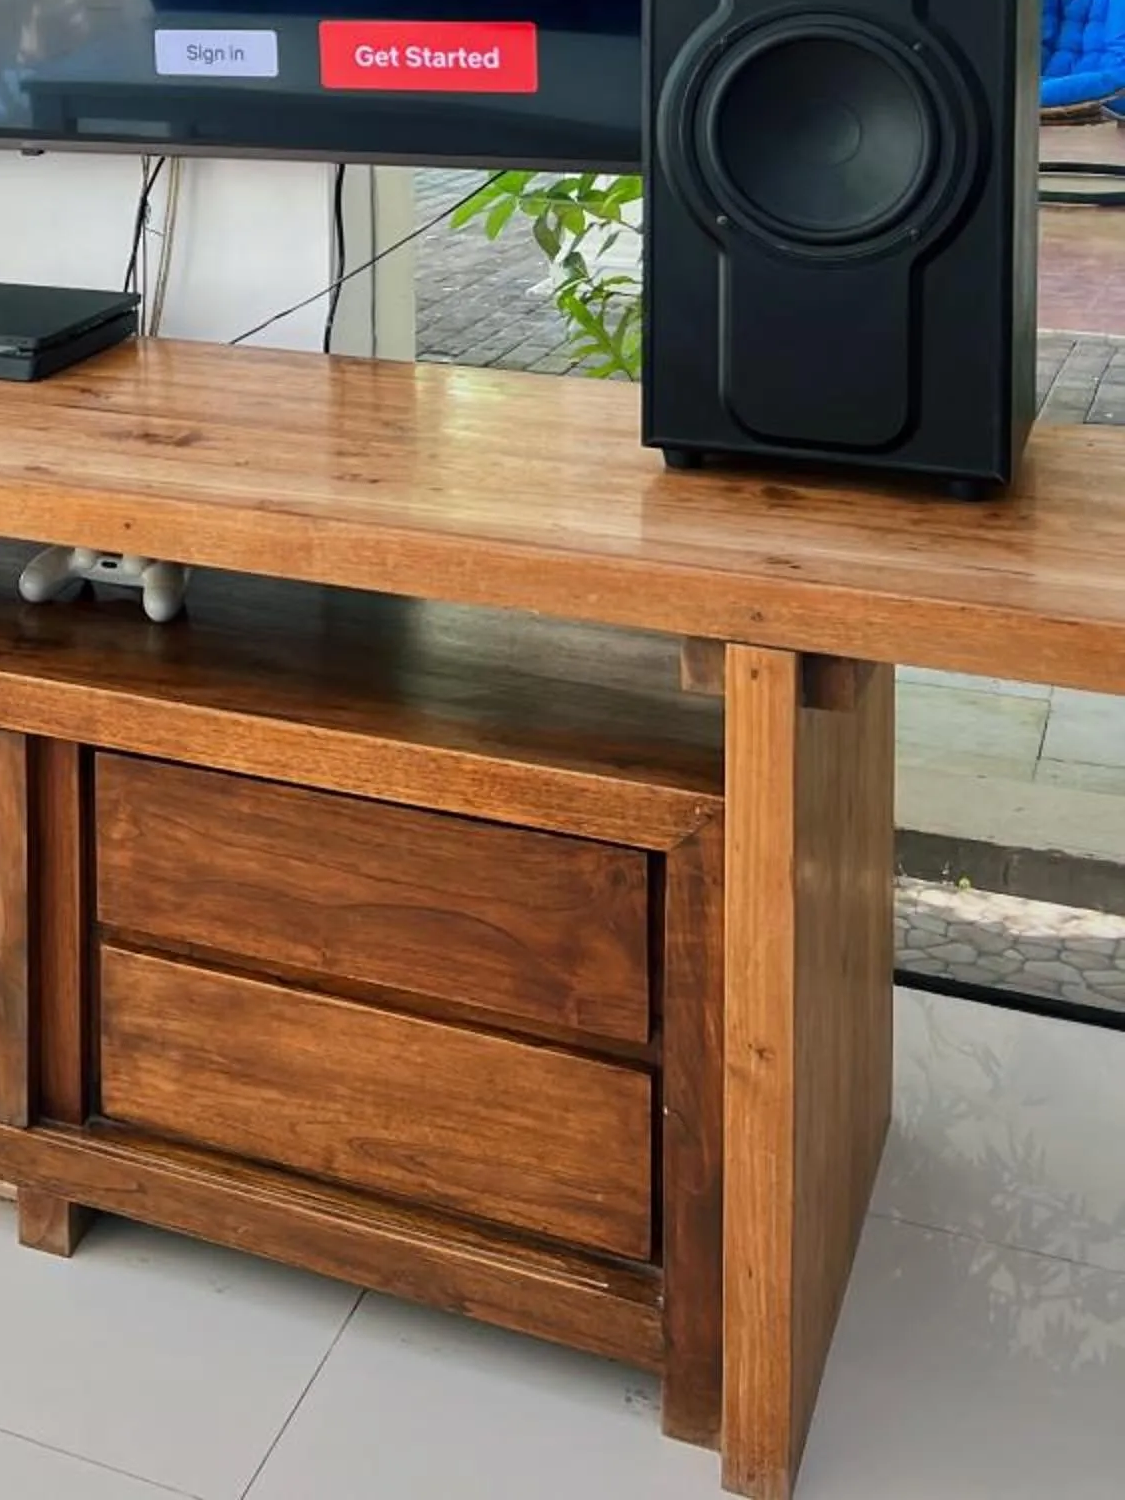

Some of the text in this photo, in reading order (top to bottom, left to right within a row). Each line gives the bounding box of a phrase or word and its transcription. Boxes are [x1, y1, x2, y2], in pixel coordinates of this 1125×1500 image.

[186, 44, 245, 65] Sign in
[354, 44, 500, 69] Get Started
